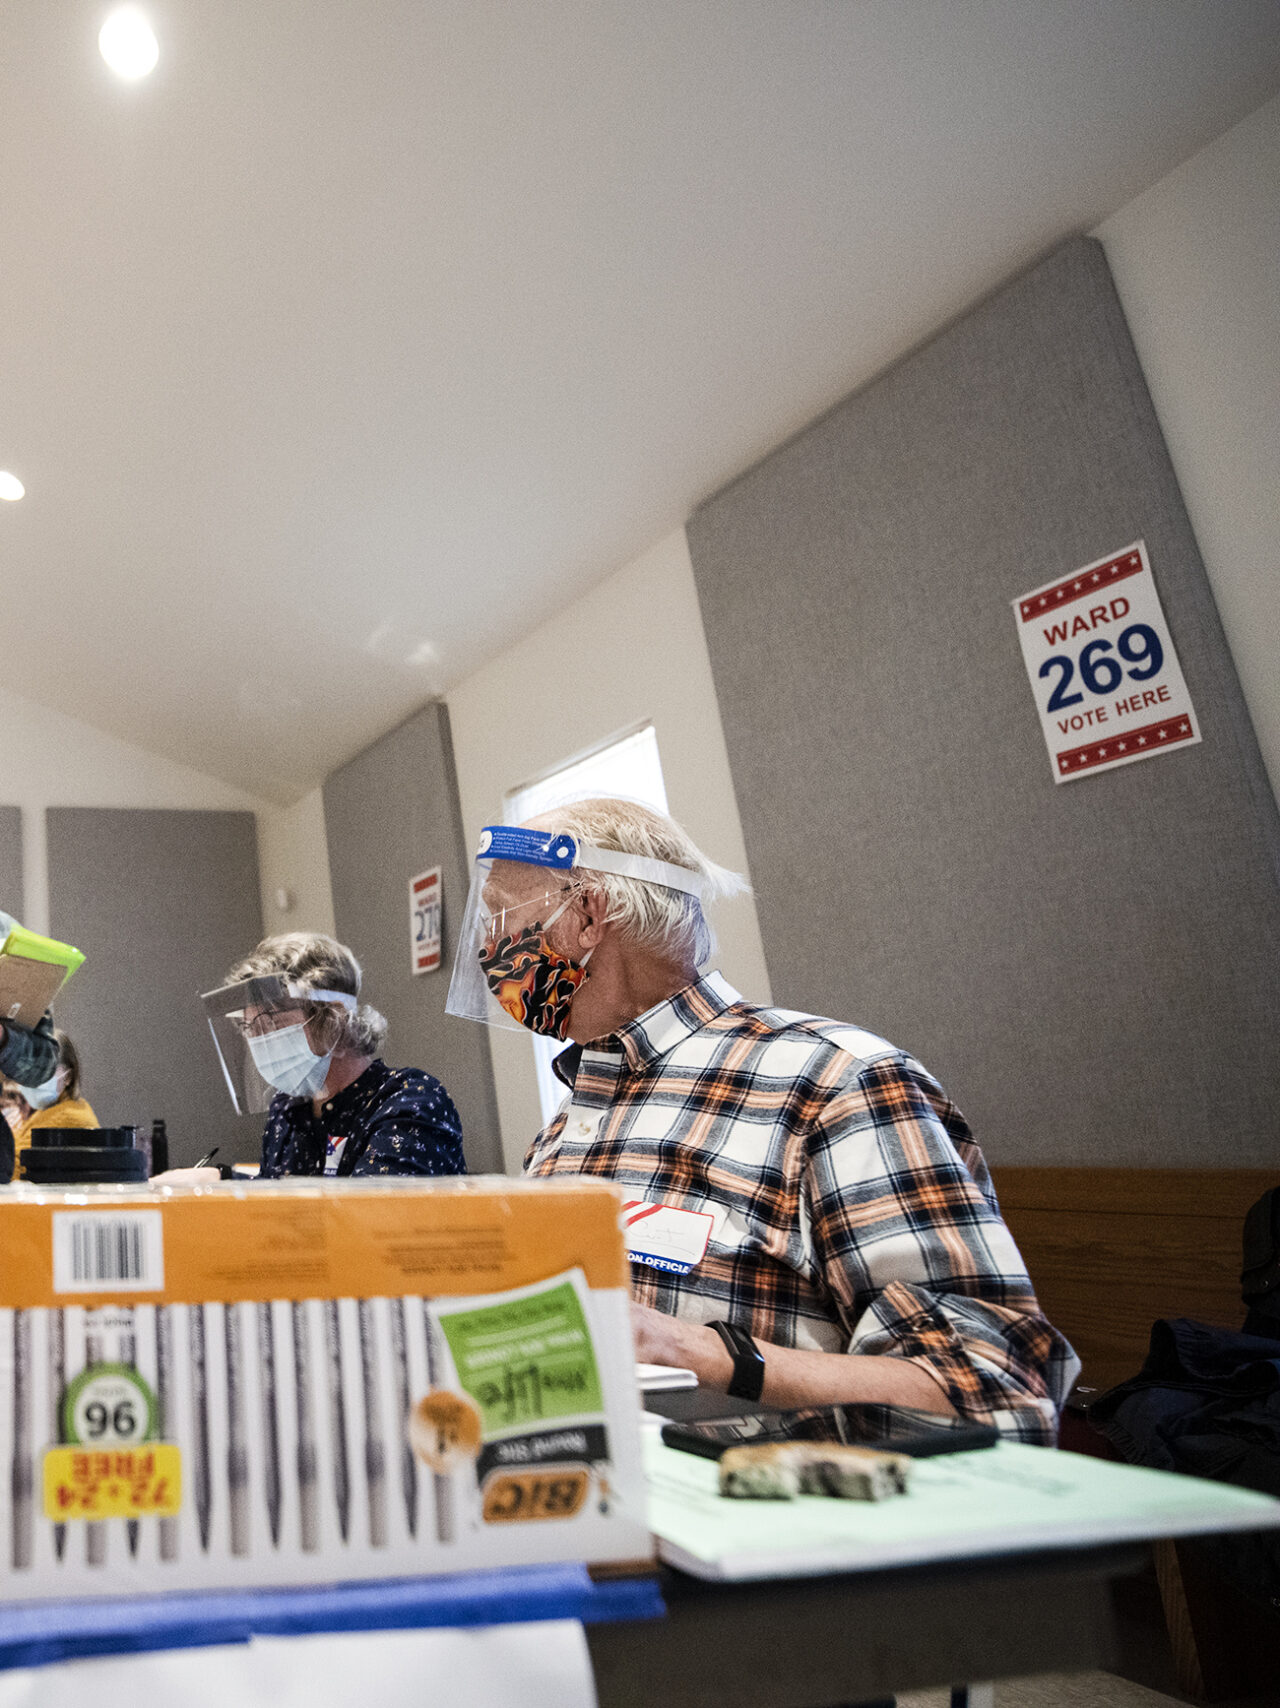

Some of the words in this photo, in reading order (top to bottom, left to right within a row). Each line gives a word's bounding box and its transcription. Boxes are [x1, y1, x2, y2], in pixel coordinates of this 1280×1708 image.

[1043, 597, 1130, 646] WARD
[1038, 623, 1164, 713] 269
[1057, 707, 1109, 734] VOTE
[1115, 685, 1172, 716] HERE
[644, 1256, 689, 1275] OFFICIA
[84, 1401, 137, 1439] 96
[73, 1451, 155, 1484] FREE
